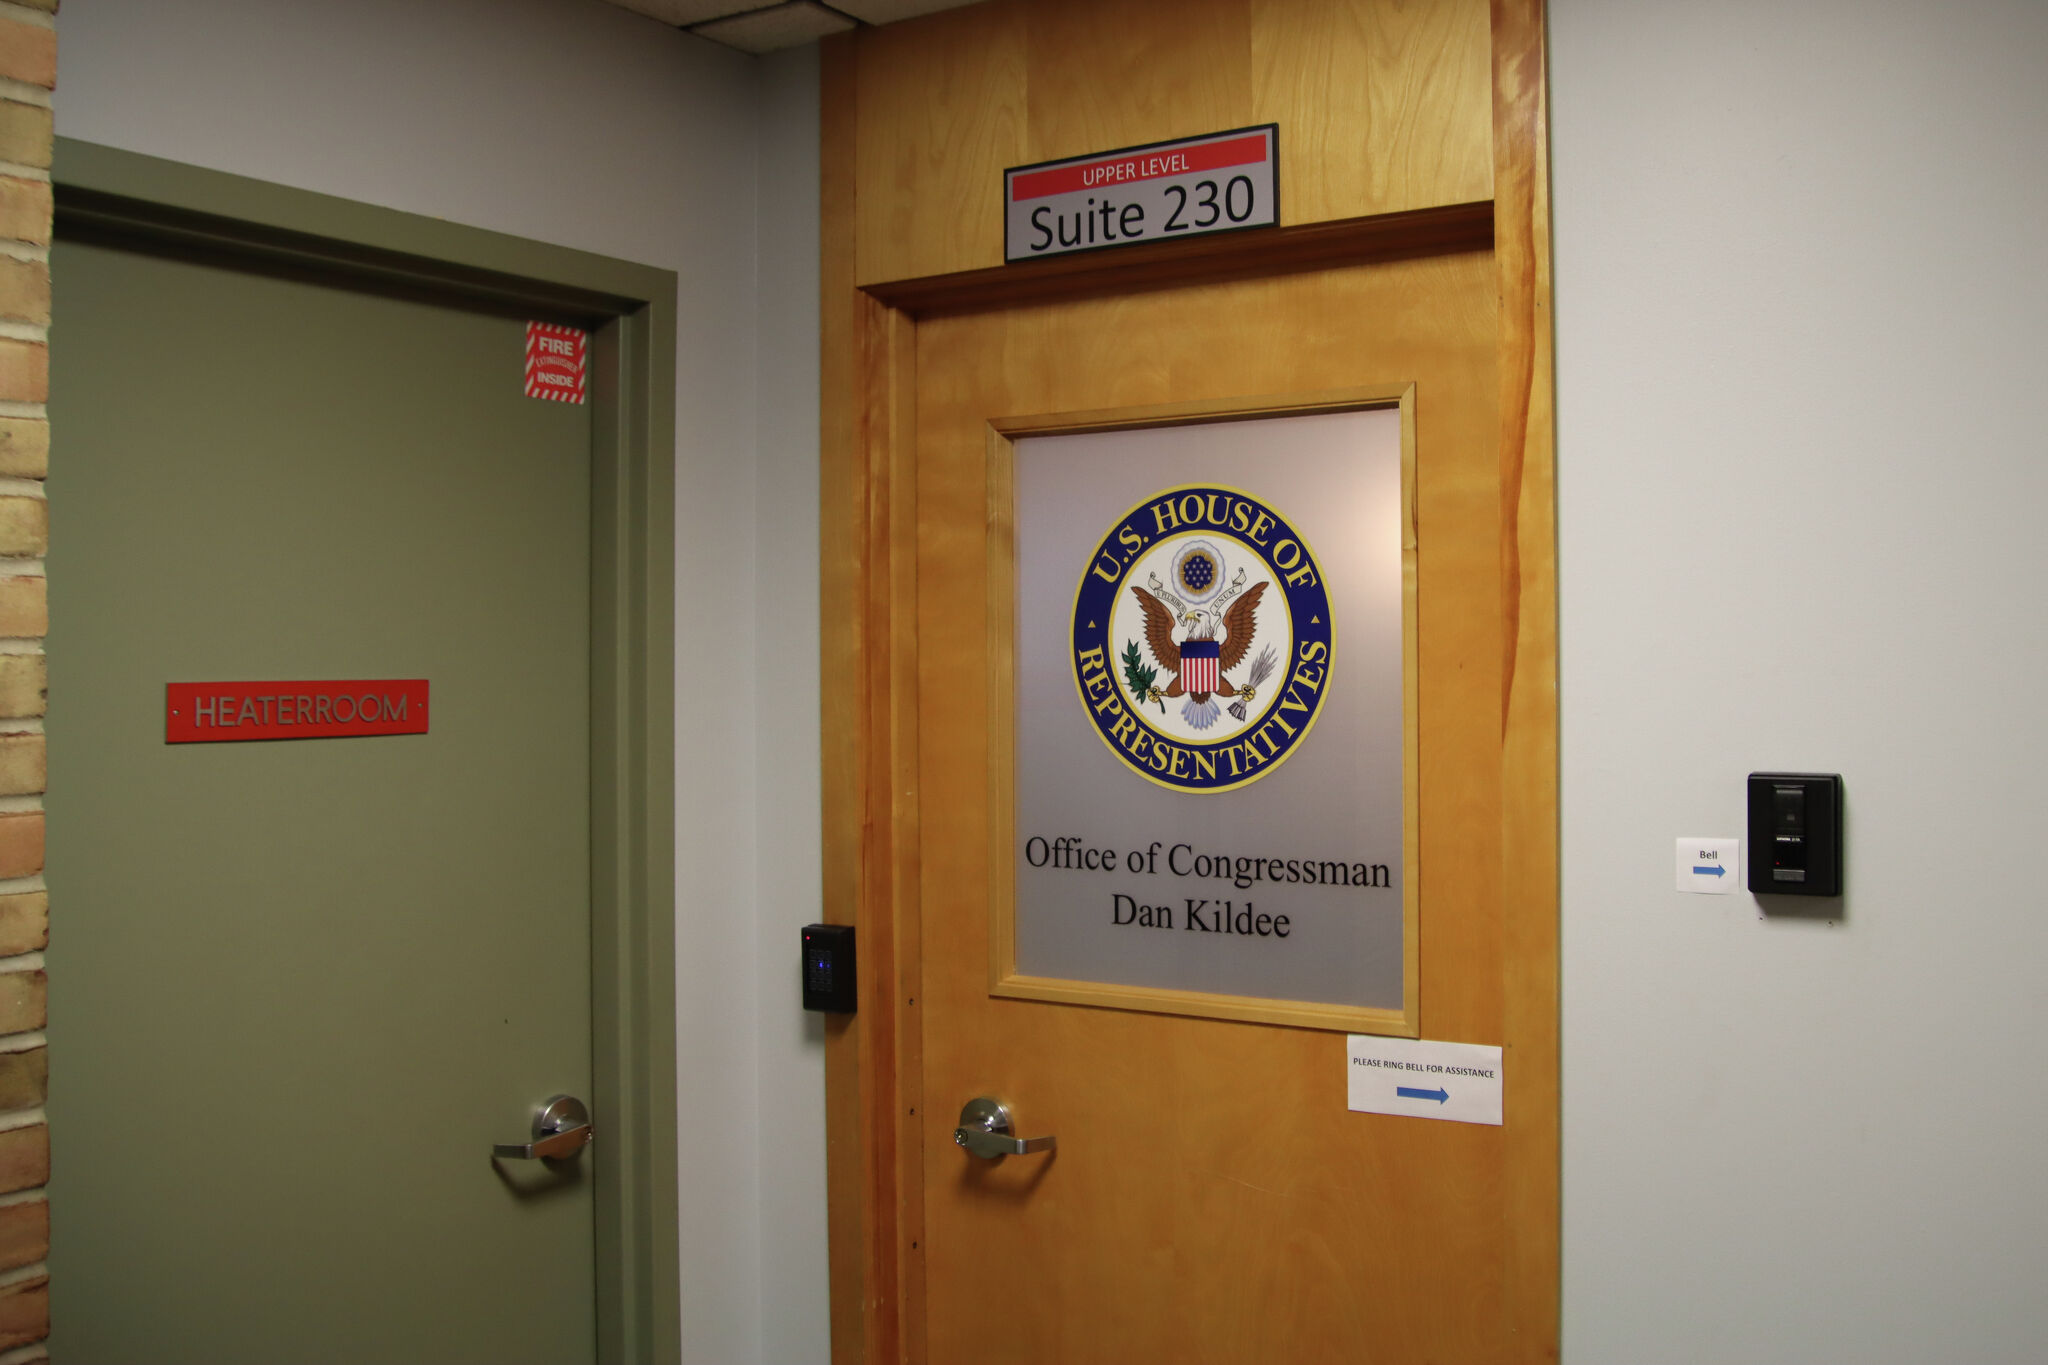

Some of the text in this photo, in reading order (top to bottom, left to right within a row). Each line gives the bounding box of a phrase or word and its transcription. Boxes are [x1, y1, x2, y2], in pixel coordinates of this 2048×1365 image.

[1083, 154, 1189, 186] UPPER LEVEL
[1030, 175, 1254, 251] Suite 230
[539, 336, 574, 357] FIRE
[537, 372, 574, 388] INSIDE
[1093, 494, 1317, 588] U.S. HOUSE OF
[1214, 589, 1236, 609] UNUM
[195, 694, 408, 727] HEATERROOM
[1078, 640, 1327, 780] REPRESENTATIVES
[1025, 836, 1392, 889] Office of Congressman
[1699, 850, 1718, 860] Bell
[1111, 893, 1290, 938] Dan Kildee
[1353, 1057, 1495, 1078] PLEASE RING BELL FOR ASSISTANCE
